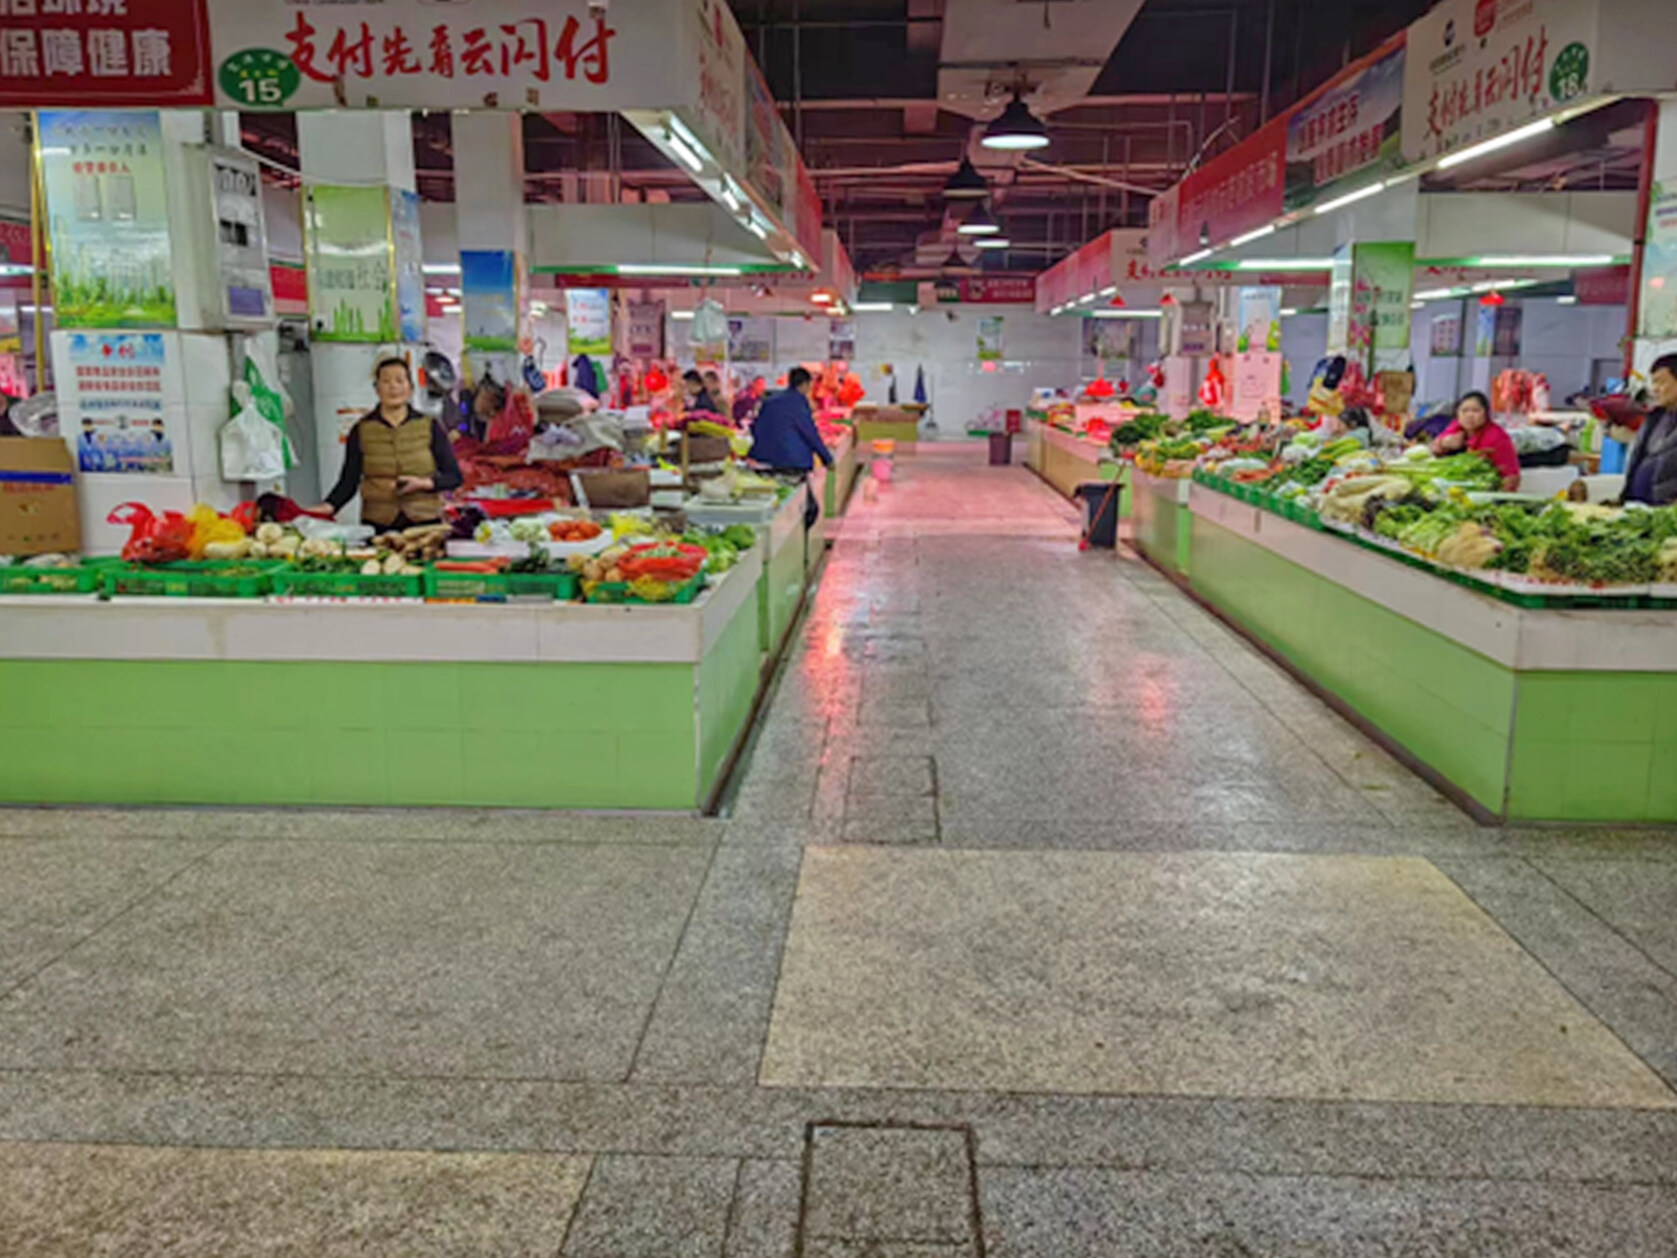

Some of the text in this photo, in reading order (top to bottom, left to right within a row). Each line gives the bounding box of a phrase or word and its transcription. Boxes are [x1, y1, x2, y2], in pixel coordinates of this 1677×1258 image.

[0, 28, 171, 76] 保障健康
[285, 11, 616, 84] 支付先看云闪付
[238, 79, 282, 102] 15
